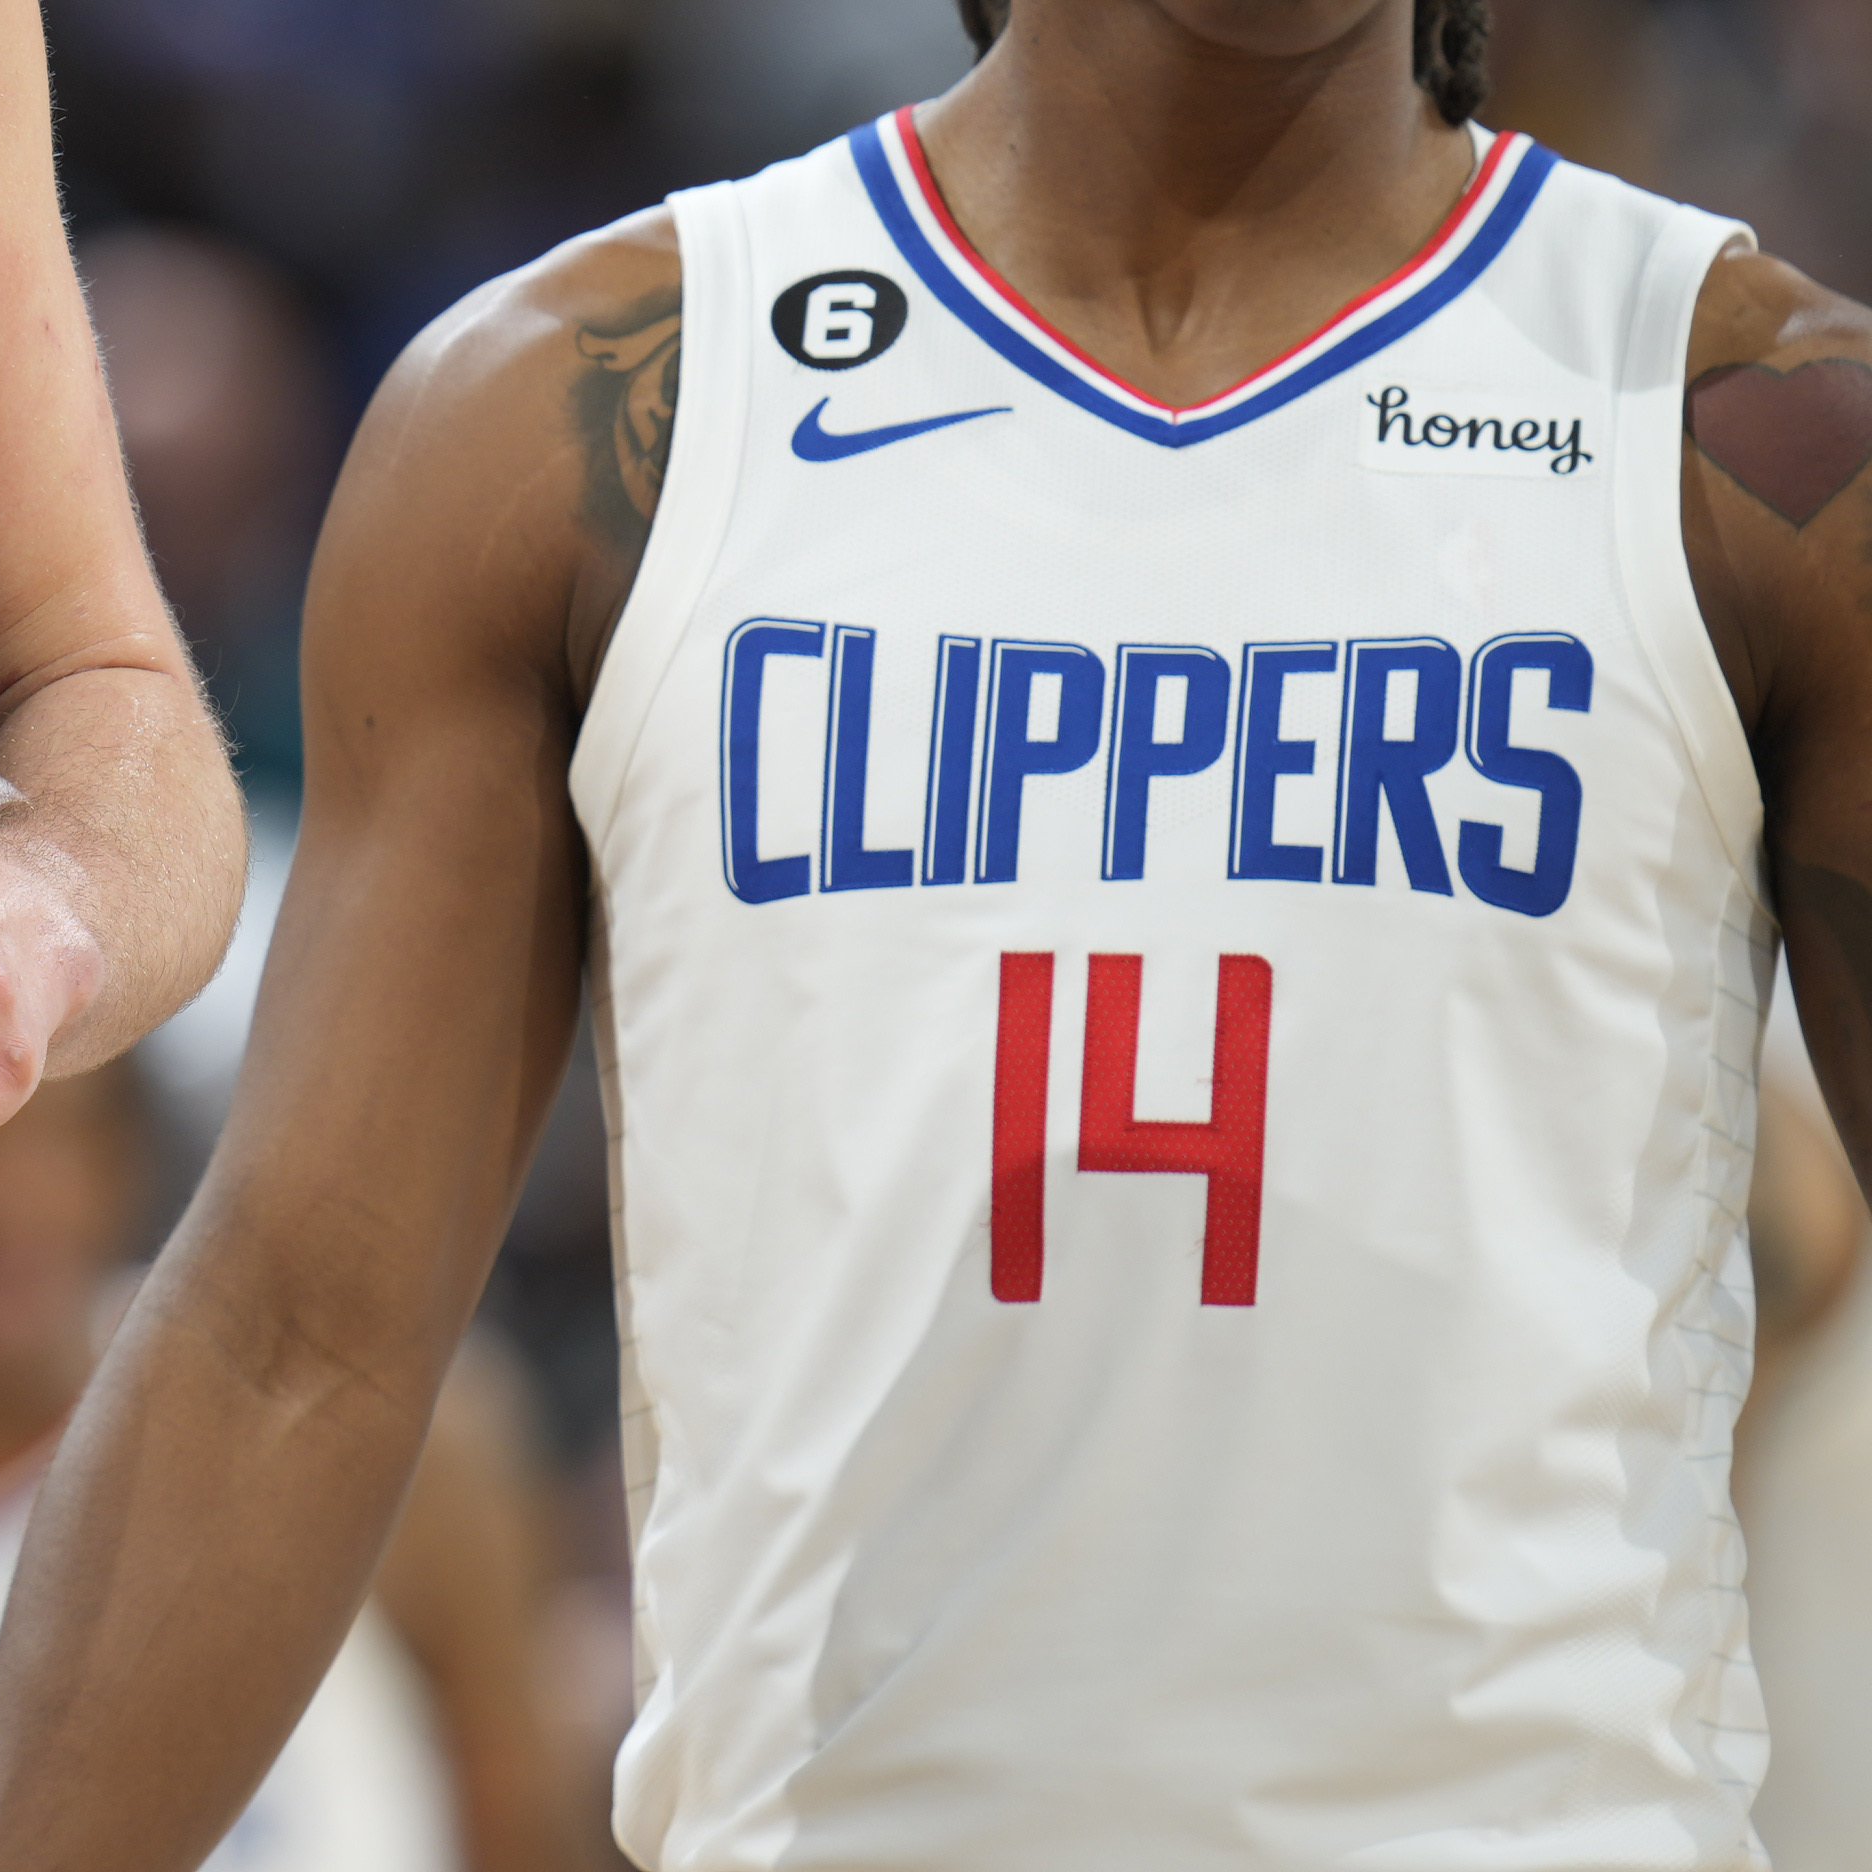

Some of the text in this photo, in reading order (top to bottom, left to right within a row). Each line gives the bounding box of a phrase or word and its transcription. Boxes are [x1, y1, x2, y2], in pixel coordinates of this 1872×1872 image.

[799, 281, 877, 360] 6
[1366, 385, 1594, 475] honey
[720, 616, 1595, 918] CLIPPERS
[991, 951, 1274, 1307] 14
